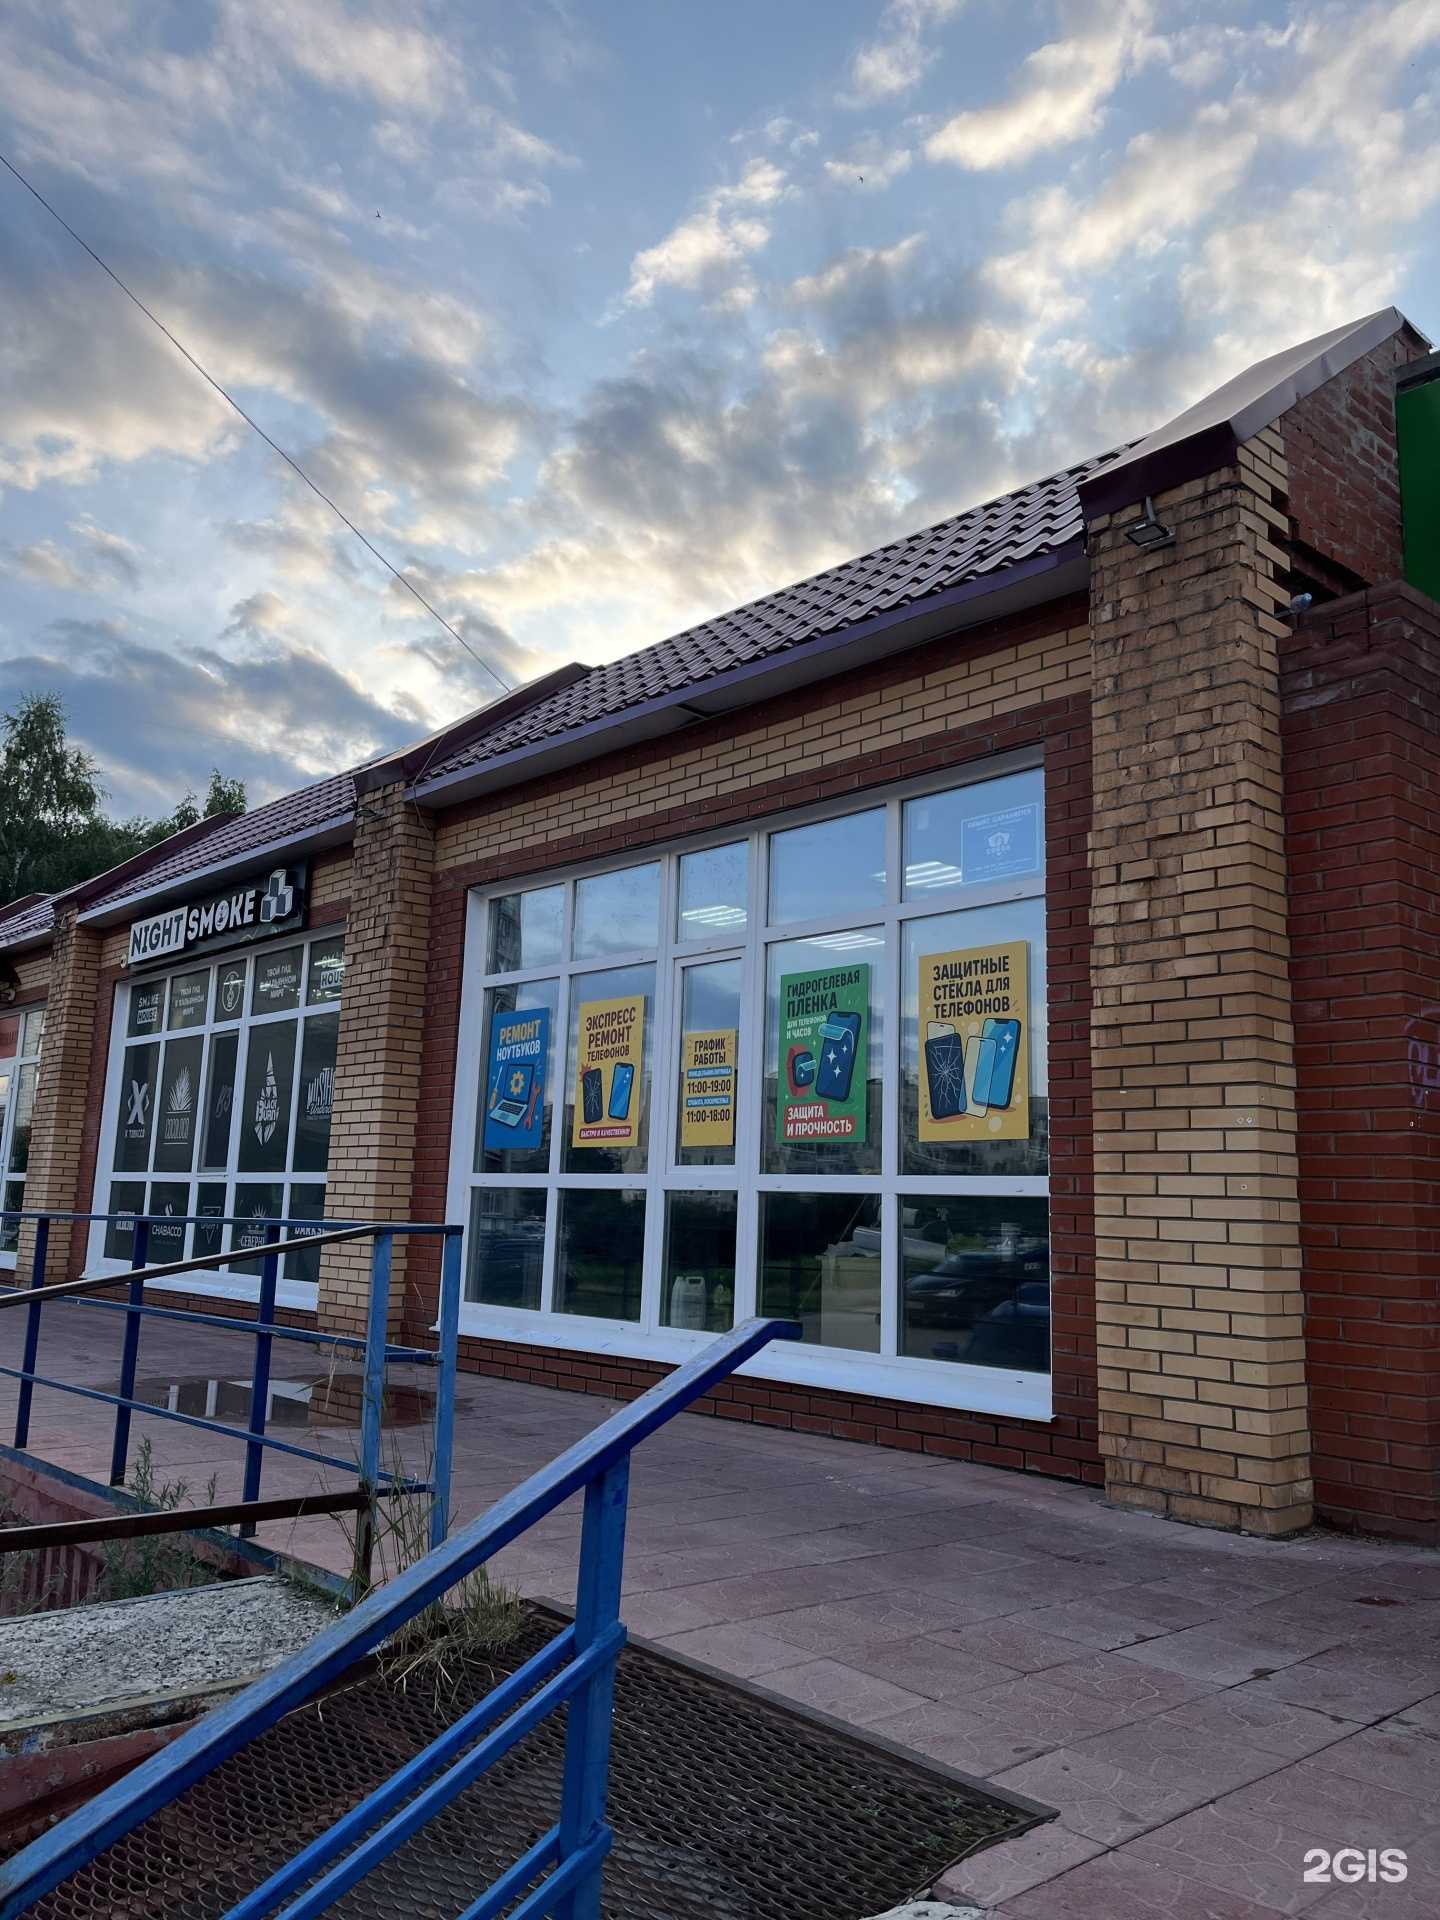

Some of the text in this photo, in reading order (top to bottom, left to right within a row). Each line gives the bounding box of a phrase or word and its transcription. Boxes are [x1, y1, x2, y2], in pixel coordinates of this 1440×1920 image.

[131, 890, 256, 957] NIGHT SMOKE
[933, 956, 1010, 981] ЗАЩИТНЫЕ
[787, 970, 860, 997] ГИДРОГЕЛЕВАЯ
[933, 977, 1010, 1001] СТЁКЛА ДЛЯ
[788, 992, 837, 1019] ПЛЕНКА
[934, 996, 1010, 1018] ТЕЛЕФОНОВ
[586, 1007, 636, 1031] ЭКСПРЕСС
[500, 1019, 541, 1046] РЕМОНТ
[588, 1026, 632, 1049] РЕМОНТ
[787, 1030, 791, 1039] И
[496, 1040, 541, 1061] НОУТБУКОВ
[587, 1045, 630, 1062] ТЕЛЕФОНОВ
[694, 1039, 726, 1053] ГРАФИК
[693, 1052, 726, 1066] РАБОТЫ
[687, 1079, 731, 1094] 11:00-19:00
[687, 1109, 730, 1123] 11:00-18:00
[788, 1106, 823, 1120] ЗАЩИТА
[787, 1120, 852, 1136] И ПРОЧНОСТЬ
[152, 1225, 182, 1237] CHABACCO
